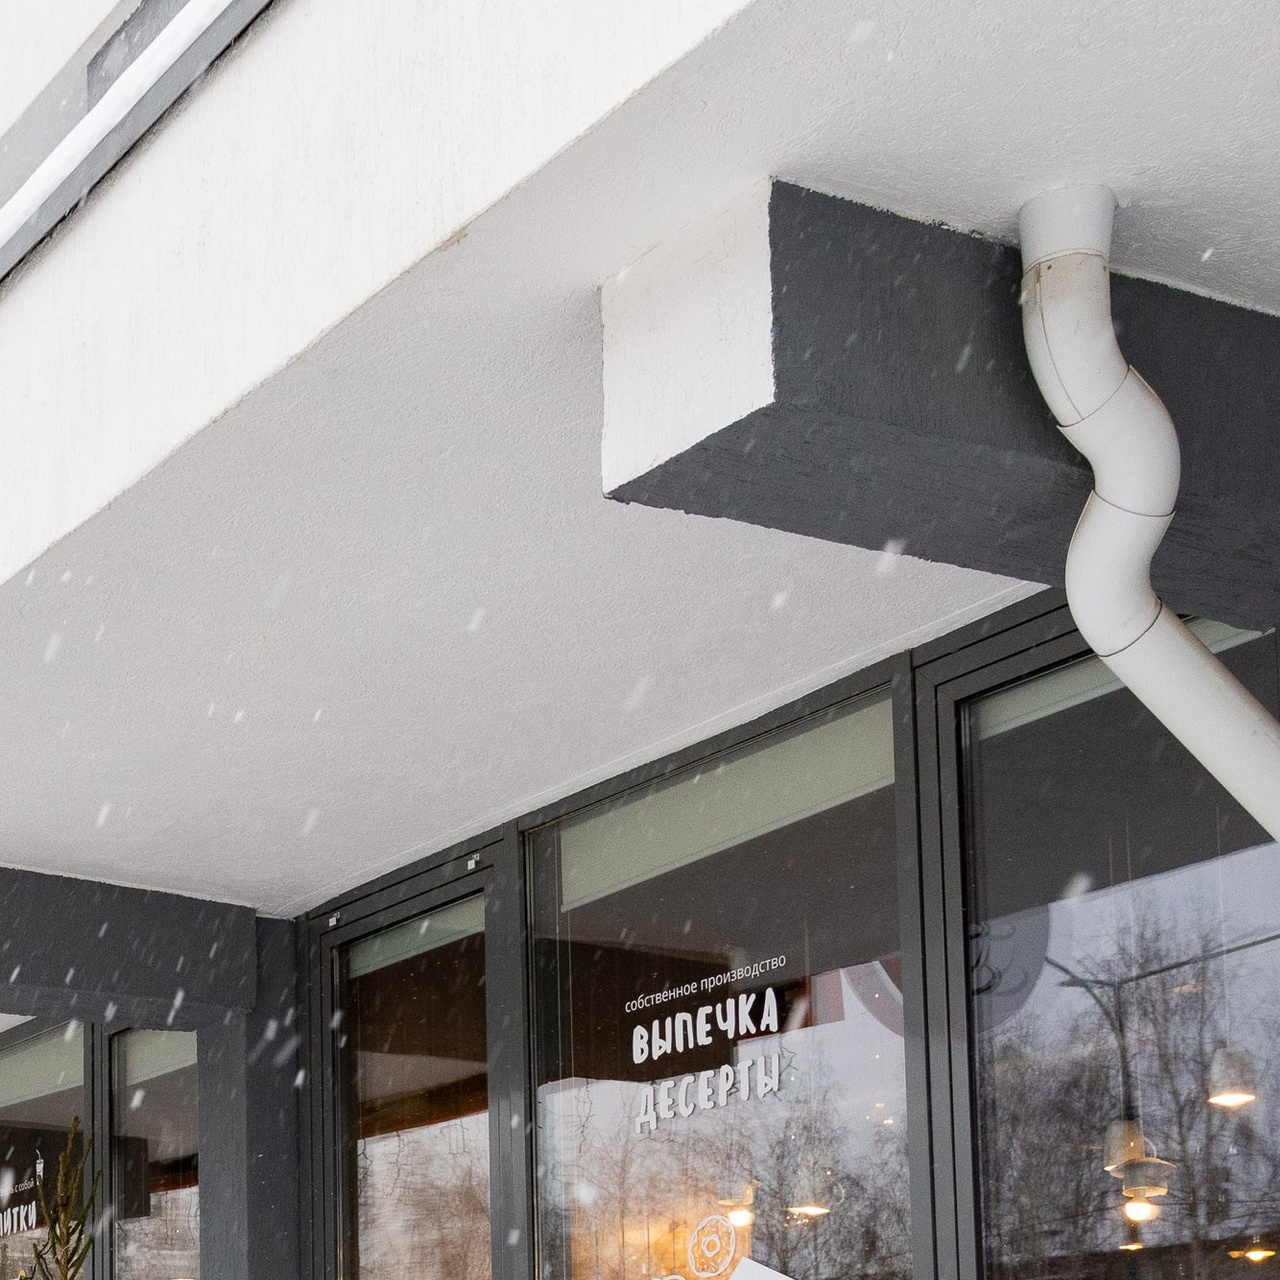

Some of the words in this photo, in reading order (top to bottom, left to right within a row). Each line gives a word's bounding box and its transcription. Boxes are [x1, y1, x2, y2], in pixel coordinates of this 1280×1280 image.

[625, 981, 698, 1013] собственное
[701, 955, 787, 993] производство
[632, 987, 779, 1065] ВЫПЕЧКА
[635, 1053, 780, 1134] ДЕСЕРТЫ
